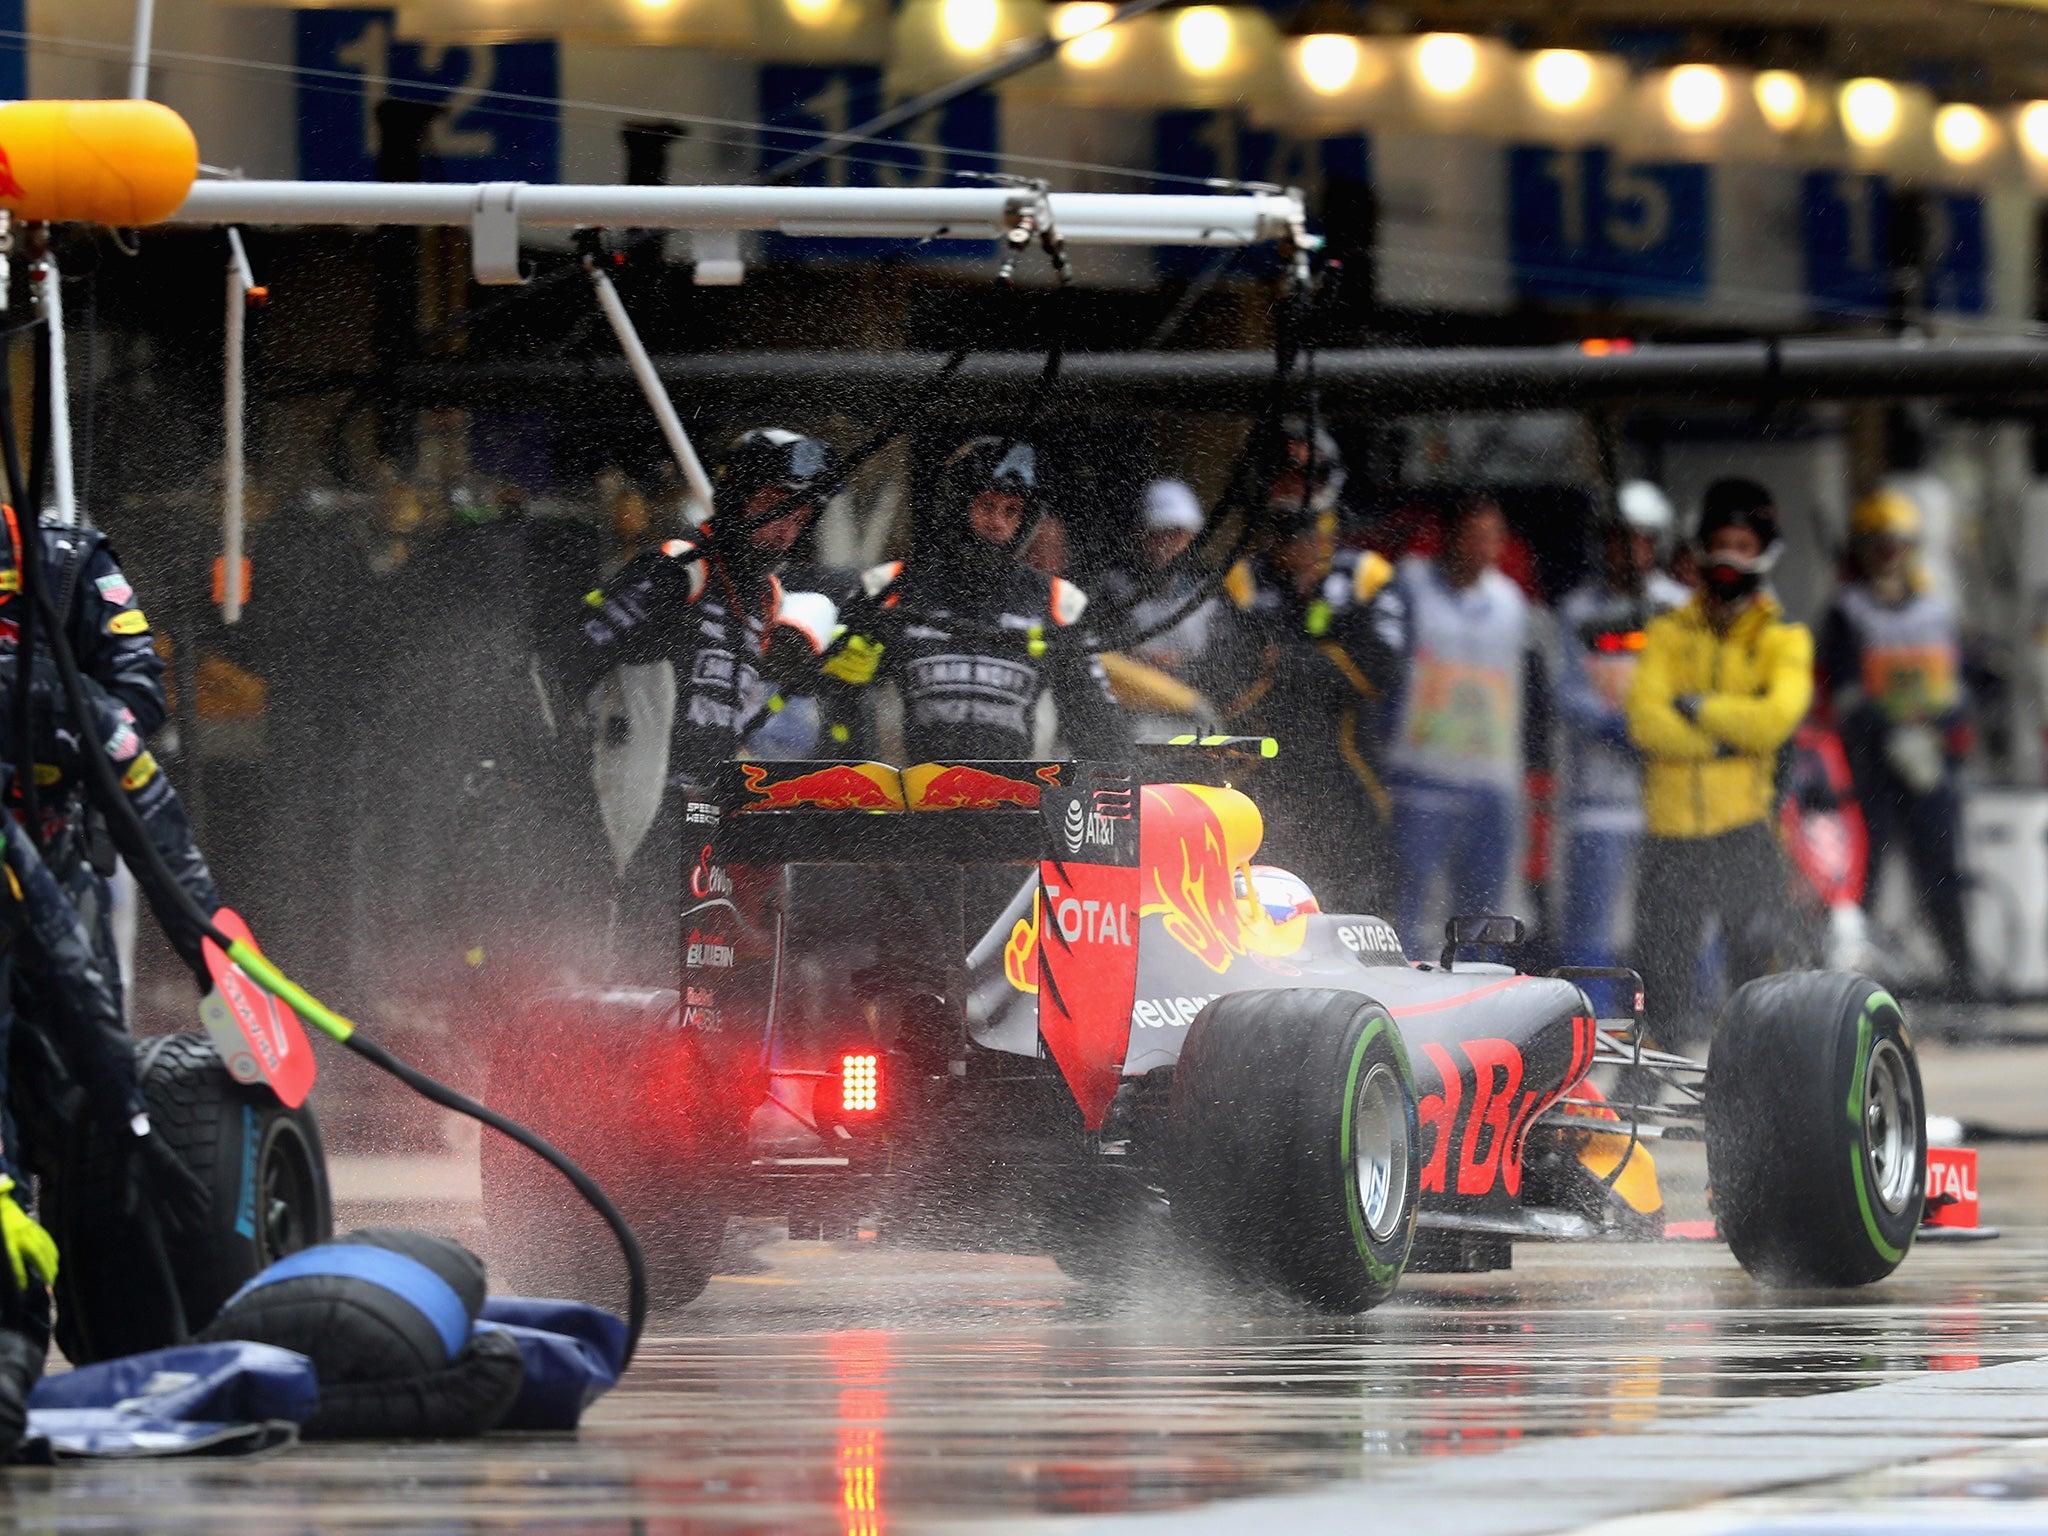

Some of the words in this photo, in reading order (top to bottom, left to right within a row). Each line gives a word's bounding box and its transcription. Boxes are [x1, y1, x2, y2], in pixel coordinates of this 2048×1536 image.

[1542, 148, 1672, 252] 15
[1085, 812, 1115, 846] AT&T
[1045, 885, 1132, 947] TOTAL
